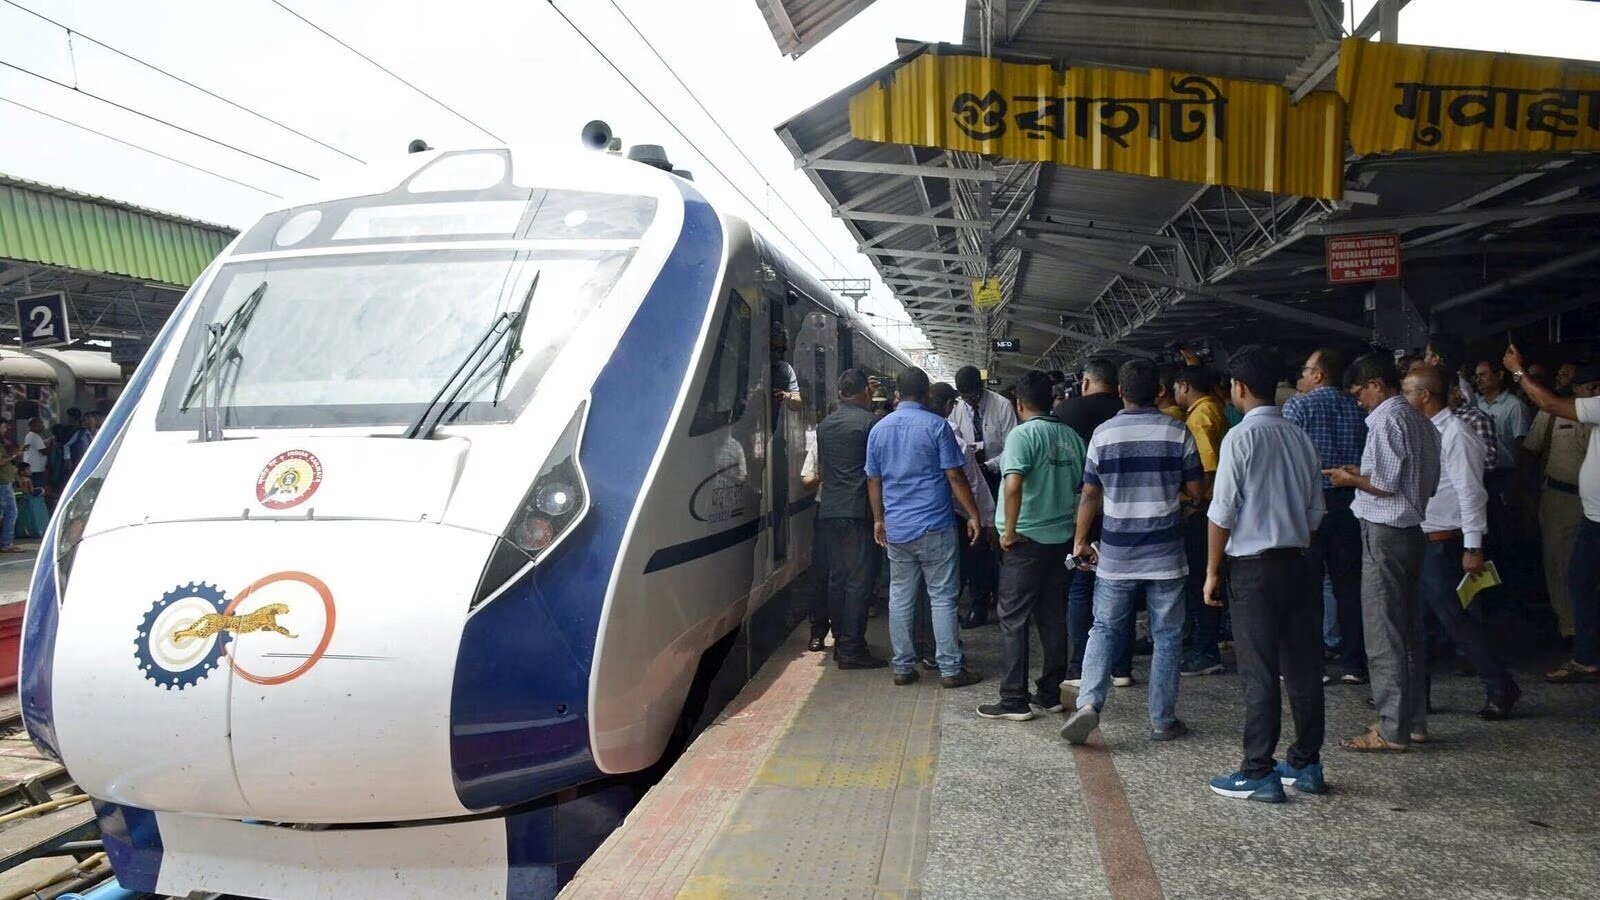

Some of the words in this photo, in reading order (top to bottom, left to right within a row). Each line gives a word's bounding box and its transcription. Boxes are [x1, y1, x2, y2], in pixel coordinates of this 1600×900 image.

[1332, 259, 1370, 269] PENALTY
[1371, 257, 1395, 266] UPTO
[1344, 270, 1359, 278] Rs.
[1359, 268, 1387, 277] 500/-
[30, 305, 54, 337] 2
